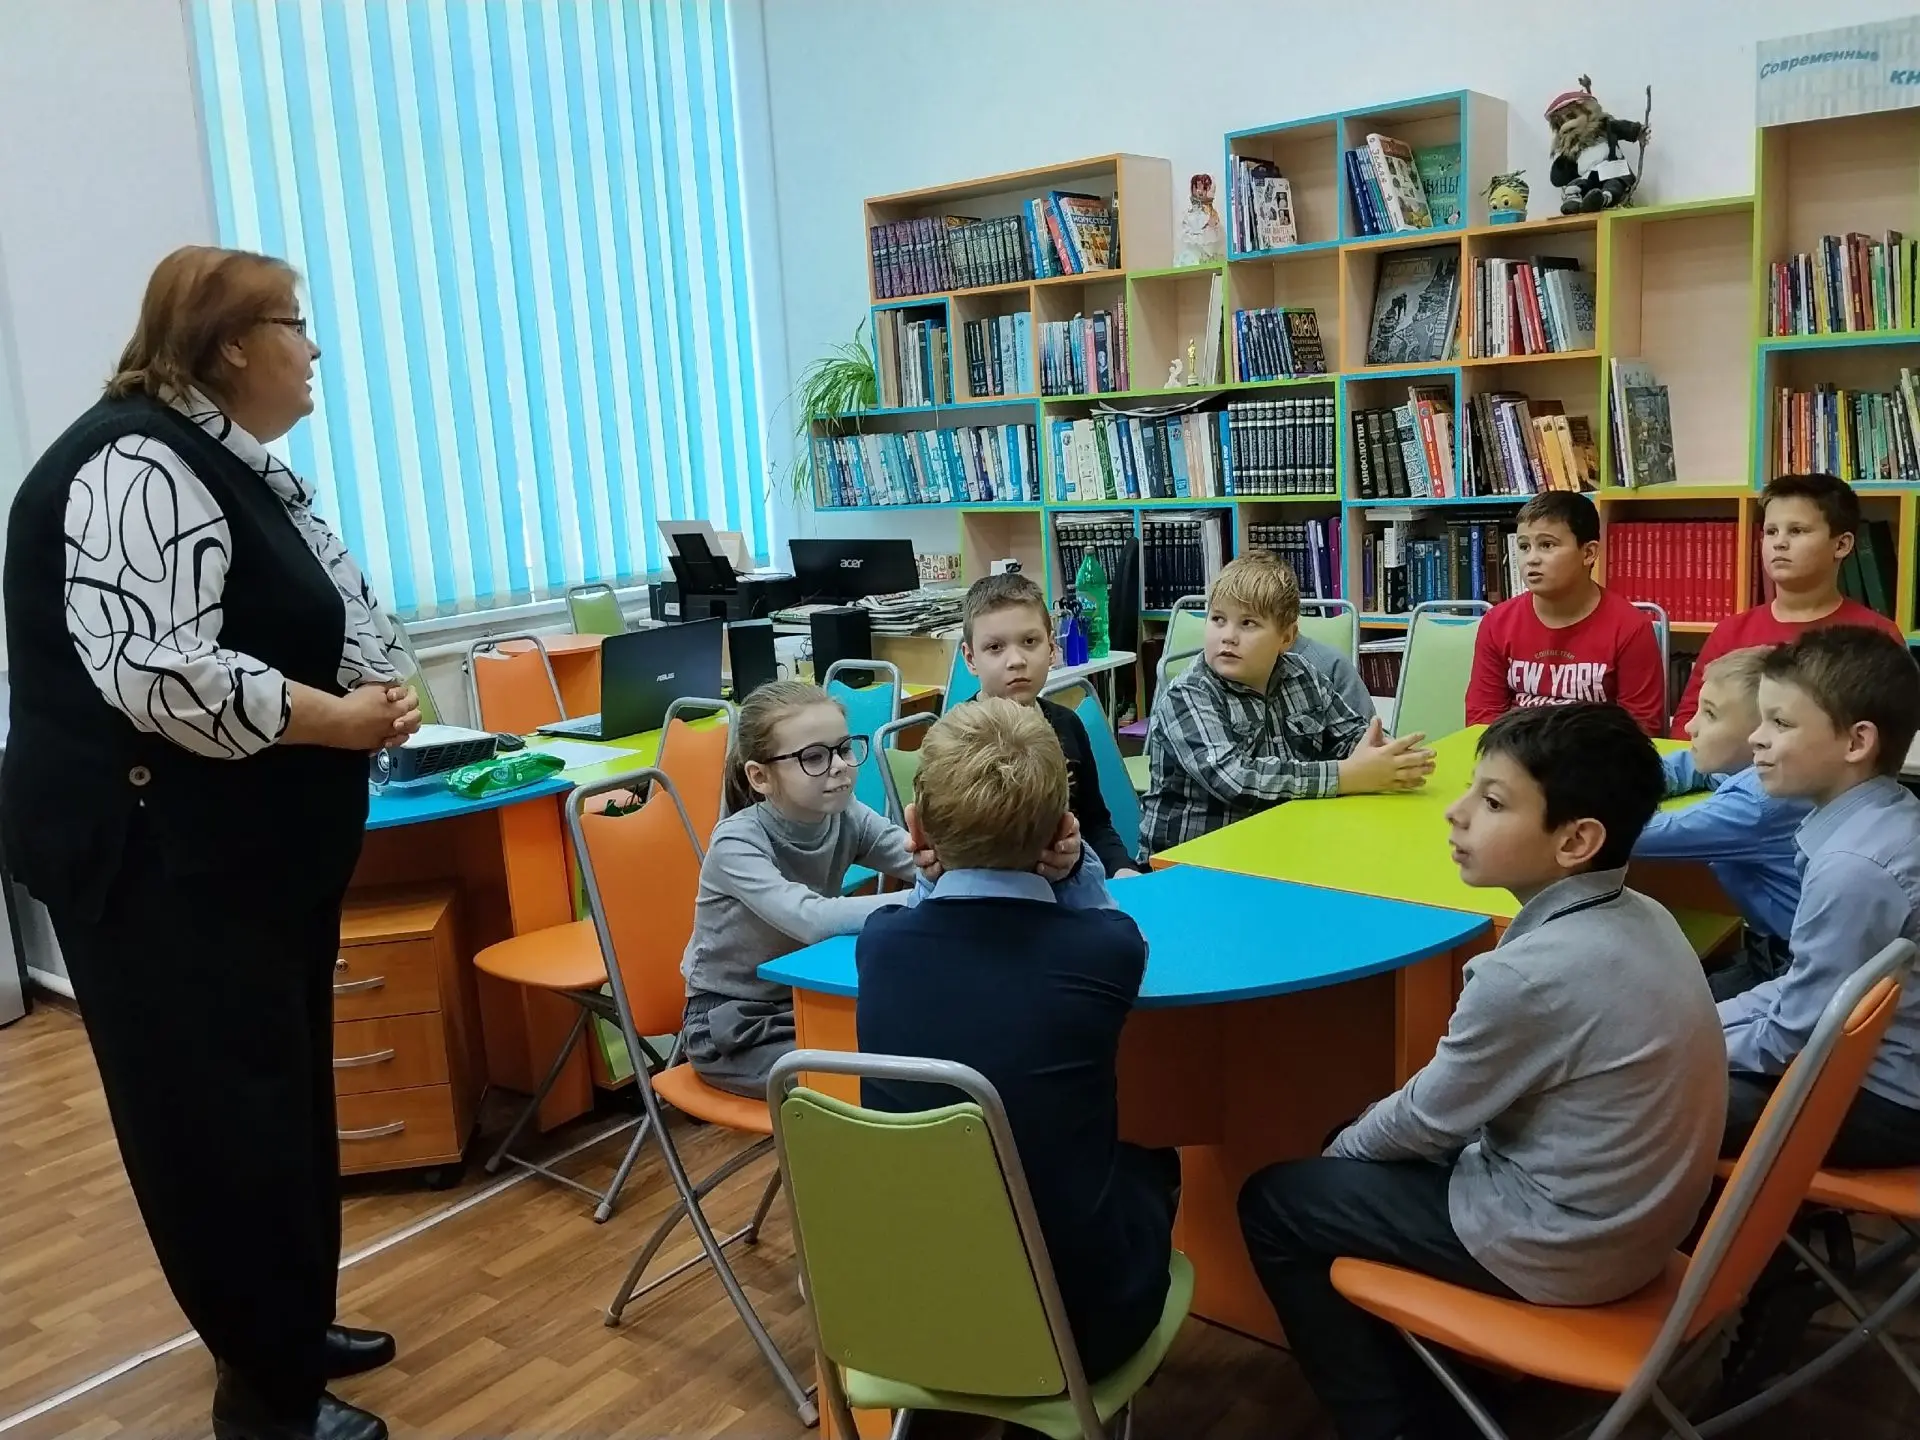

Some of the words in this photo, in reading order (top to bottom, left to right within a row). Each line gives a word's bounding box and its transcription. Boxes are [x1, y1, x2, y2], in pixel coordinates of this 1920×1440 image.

[1759, 49, 1880, 80] Современные
[1357, 423, 1370, 486] МИФОЛОГИЯ
[840, 559, 863, 568] acer
[656, 672, 675, 682] ASUS
[1549, 662, 1607, 703] YORK
